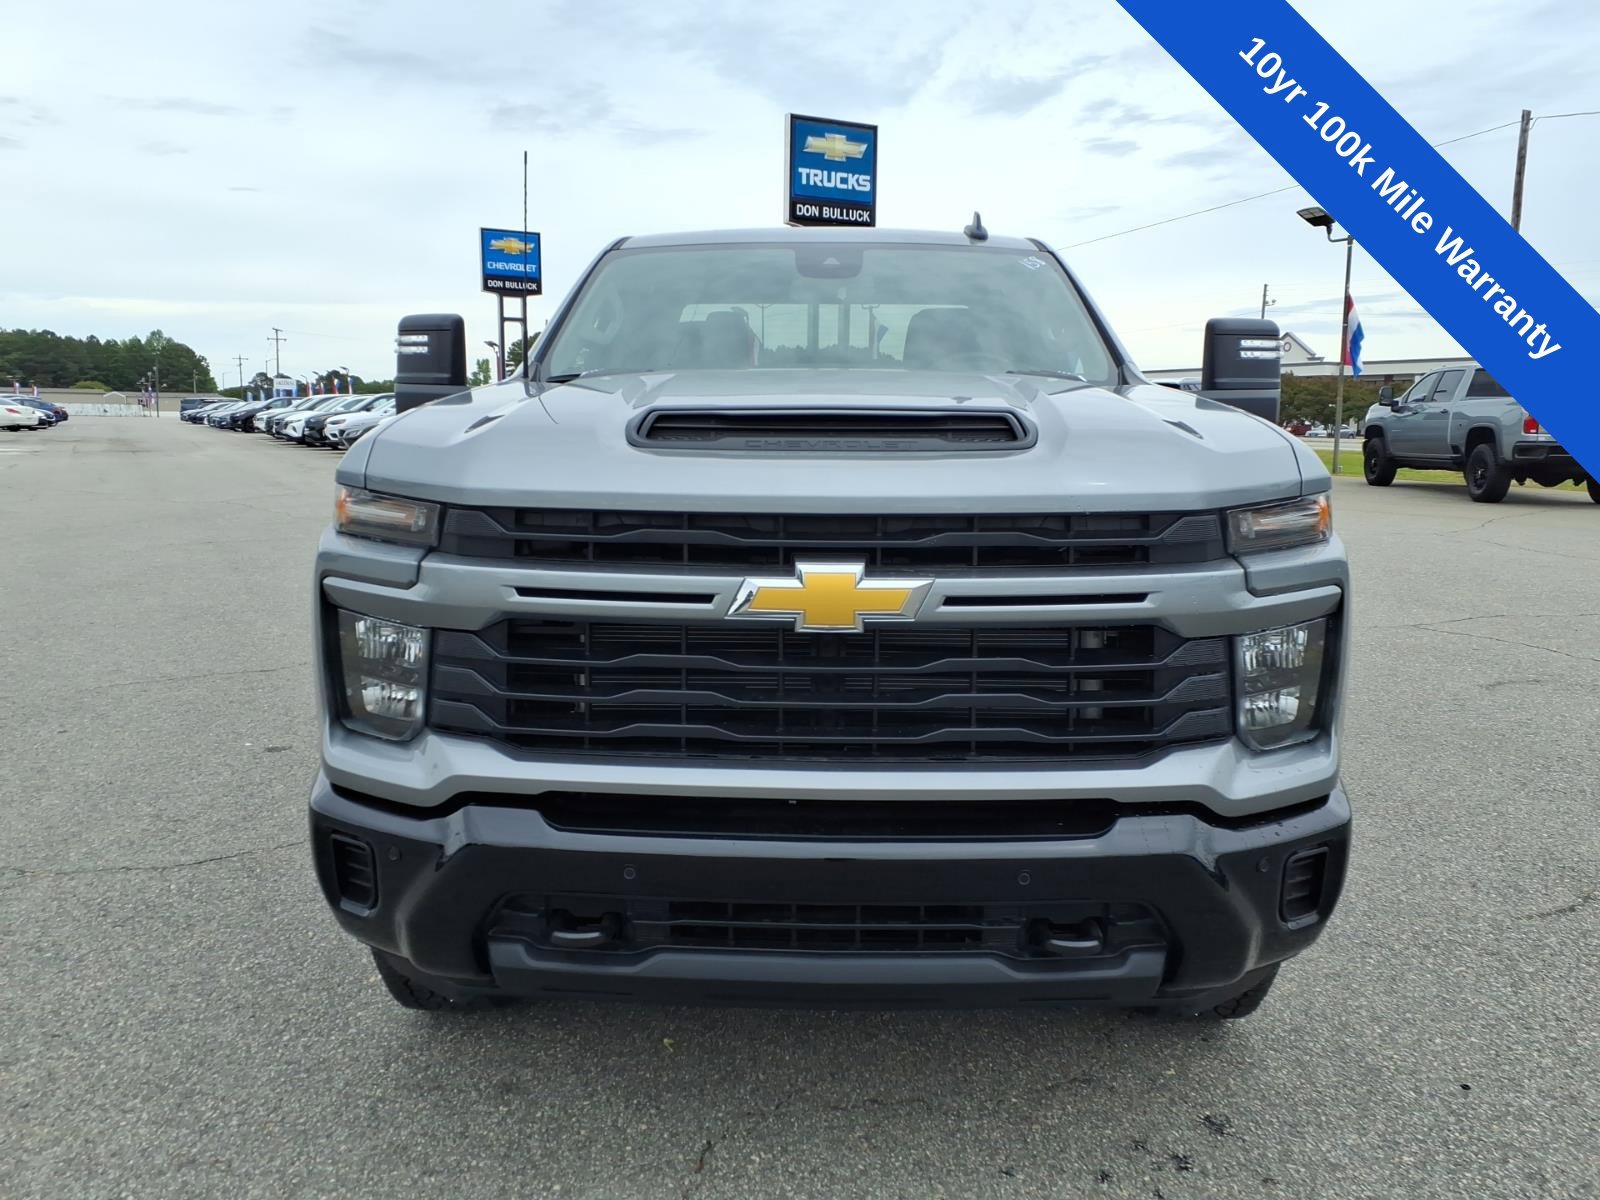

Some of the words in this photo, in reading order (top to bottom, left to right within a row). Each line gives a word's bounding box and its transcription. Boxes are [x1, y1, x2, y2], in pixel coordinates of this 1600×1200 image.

[798, 167, 871, 191] TRUCKS
[796, 203, 819, 217] DON
[822, 206, 870, 222] BULLUCK
[487, 261, 536, 272] CHEVROLET
[487, 279, 503, 288] DON
[744, 439, 918, 449] CHEVROLET
